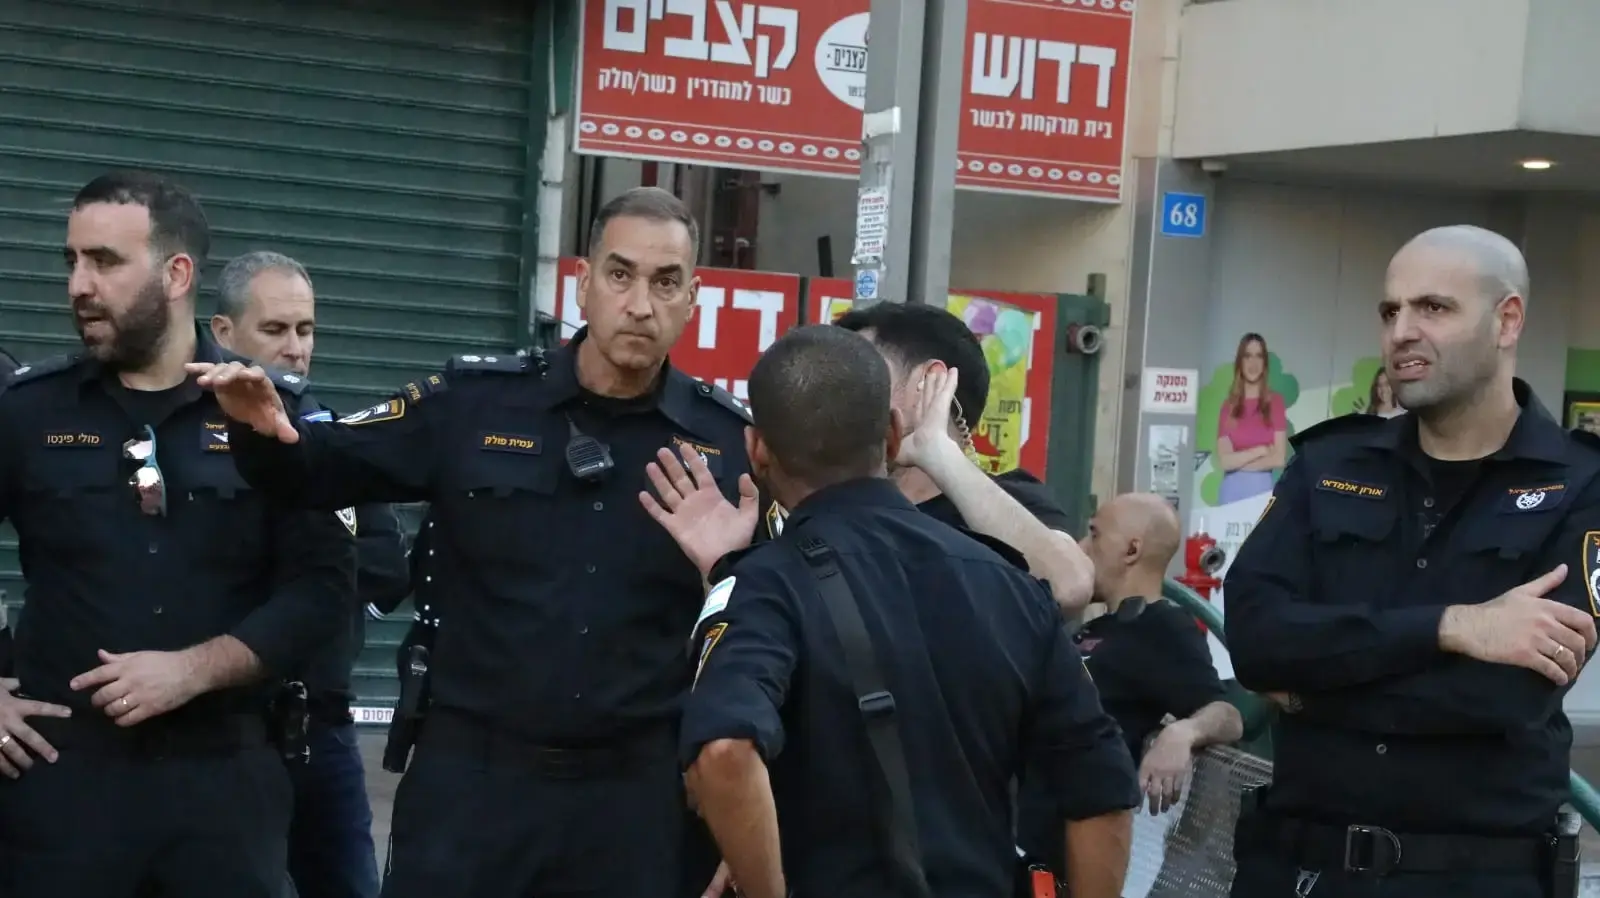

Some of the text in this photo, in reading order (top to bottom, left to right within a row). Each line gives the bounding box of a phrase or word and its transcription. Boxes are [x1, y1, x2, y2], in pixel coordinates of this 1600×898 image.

[602, 0, 799, 78] קצבים
[970, 31, 1117, 109] דדוש
[598, 66, 791, 106] כשר למהדרין כשר/חלק
[969, 108, 1113, 139] בית מרקחת לבשר
[1170, 202, 1198, 227] 68
[1156, 374, 1188, 388] הסנקה
[1153, 389, 1188, 403] לכבאית
[47, 432, 100, 444] מולי פינטו
[484, 434, 535, 449] עמית פולק
[1322, 479, 1383, 497] אורון אלמדאי
